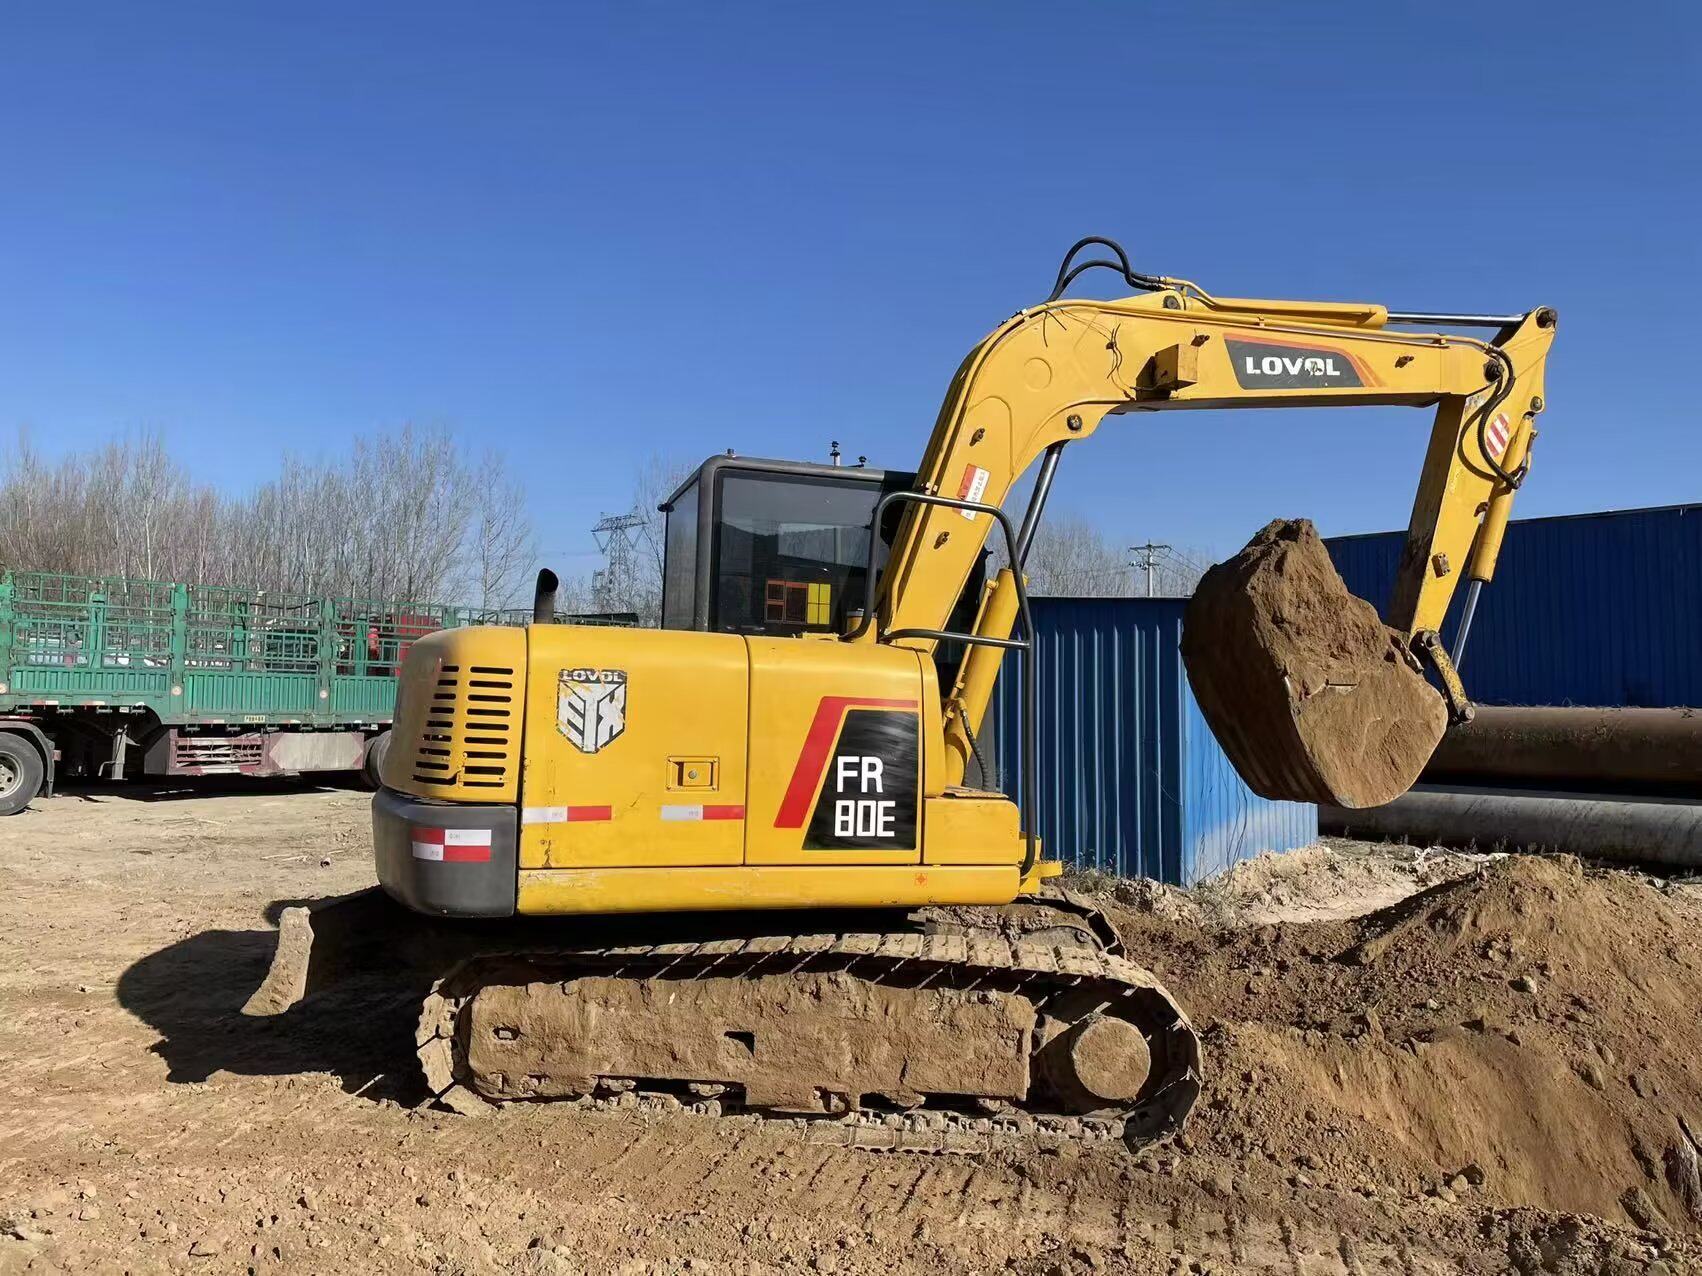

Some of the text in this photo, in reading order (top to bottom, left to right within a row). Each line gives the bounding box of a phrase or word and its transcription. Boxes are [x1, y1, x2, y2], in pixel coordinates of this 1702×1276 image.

[1245, 356, 1341, 376] LOVOL
[836, 755, 884, 793] FR
[834, 799, 896, 837] 80E
